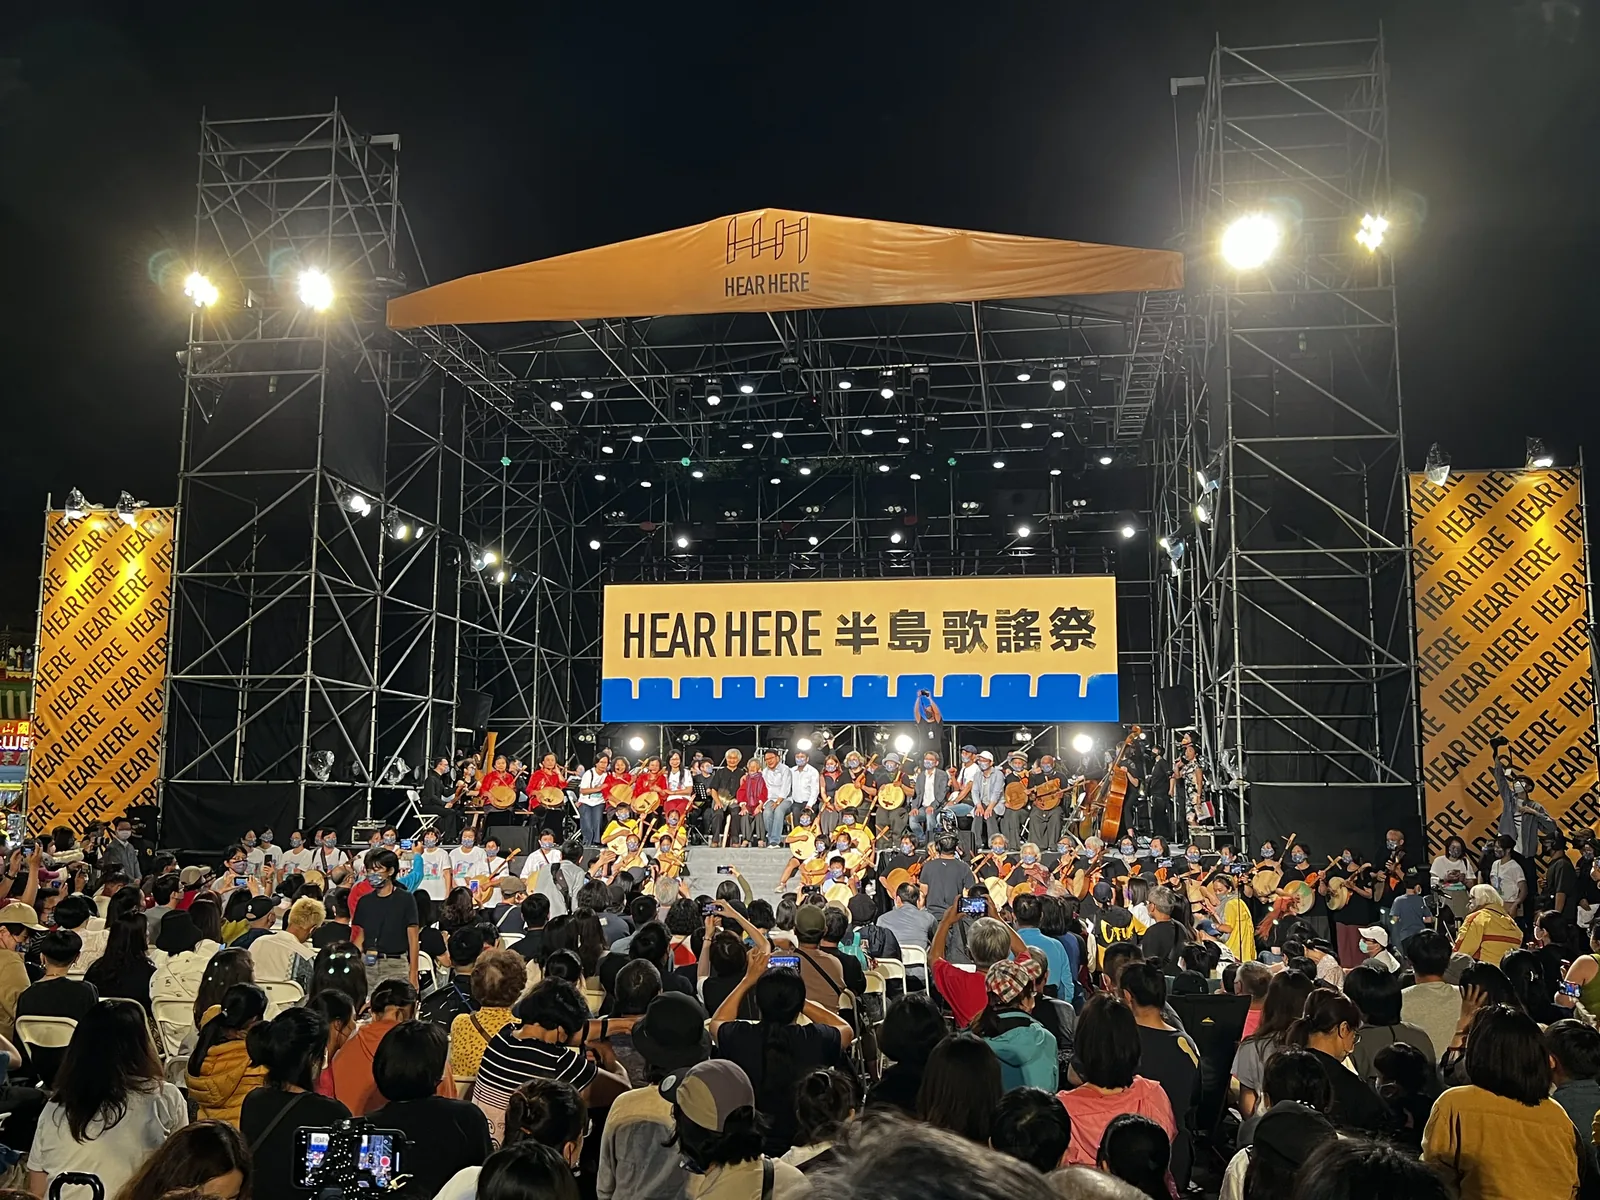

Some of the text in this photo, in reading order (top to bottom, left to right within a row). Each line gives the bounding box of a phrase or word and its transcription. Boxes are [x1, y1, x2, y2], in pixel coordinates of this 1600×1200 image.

[725, 272, 810, 297] HEAR HERE
[64, 530, 107, 572] HEAR
[1416, 569, 1472, 621] HEAR
[1456, 525, 1514, 580] HERE
[1505, 482, 1563, 532] HEAR
[1436, 493, 1492, 544] HEAR
[37, 646, 76, 692] HERE
[74, 606, 118, 650] HEAR
[108, 568, 154, 616] HERE
[42, 519, 160, 640] HEAR HERE HEAR
[624, 606, 1097, 658] HEAR HERE 半島歌謠祭
[1418, 627, 1471, 682] HERE
[1462, 582, 1519, 634] HEAR
[1503, 538, 1561, 592] HERE
[48, 676, 92, 720] HEAR
[84, 637, 128, 684] HERE
[125, 598, 170, 643] HEAR
[1439, 661, 1497, 714] HEAR
[1480, 617, 1540, 672] HERE
[1531, 572, 1586, 625] HEAR
[30, 742, 70, 788] HEAR
[60, 704, 106, 752] HERE
[102, 666, 146, 711] HEAR
[58, 754, 102, 801] HEAR
[93, 716, 139, 764] HERE
[1424, 739, 1478, 793] HEAR
[1461, 695, 1520, 752] HERE
[1510, 650, 1568, 704] HEAR
[1508, 709, 1567, 766] HERE
[1536, 746, 1594, 800] HEAR
[68, 747, 156, 836] HERE HEAR
